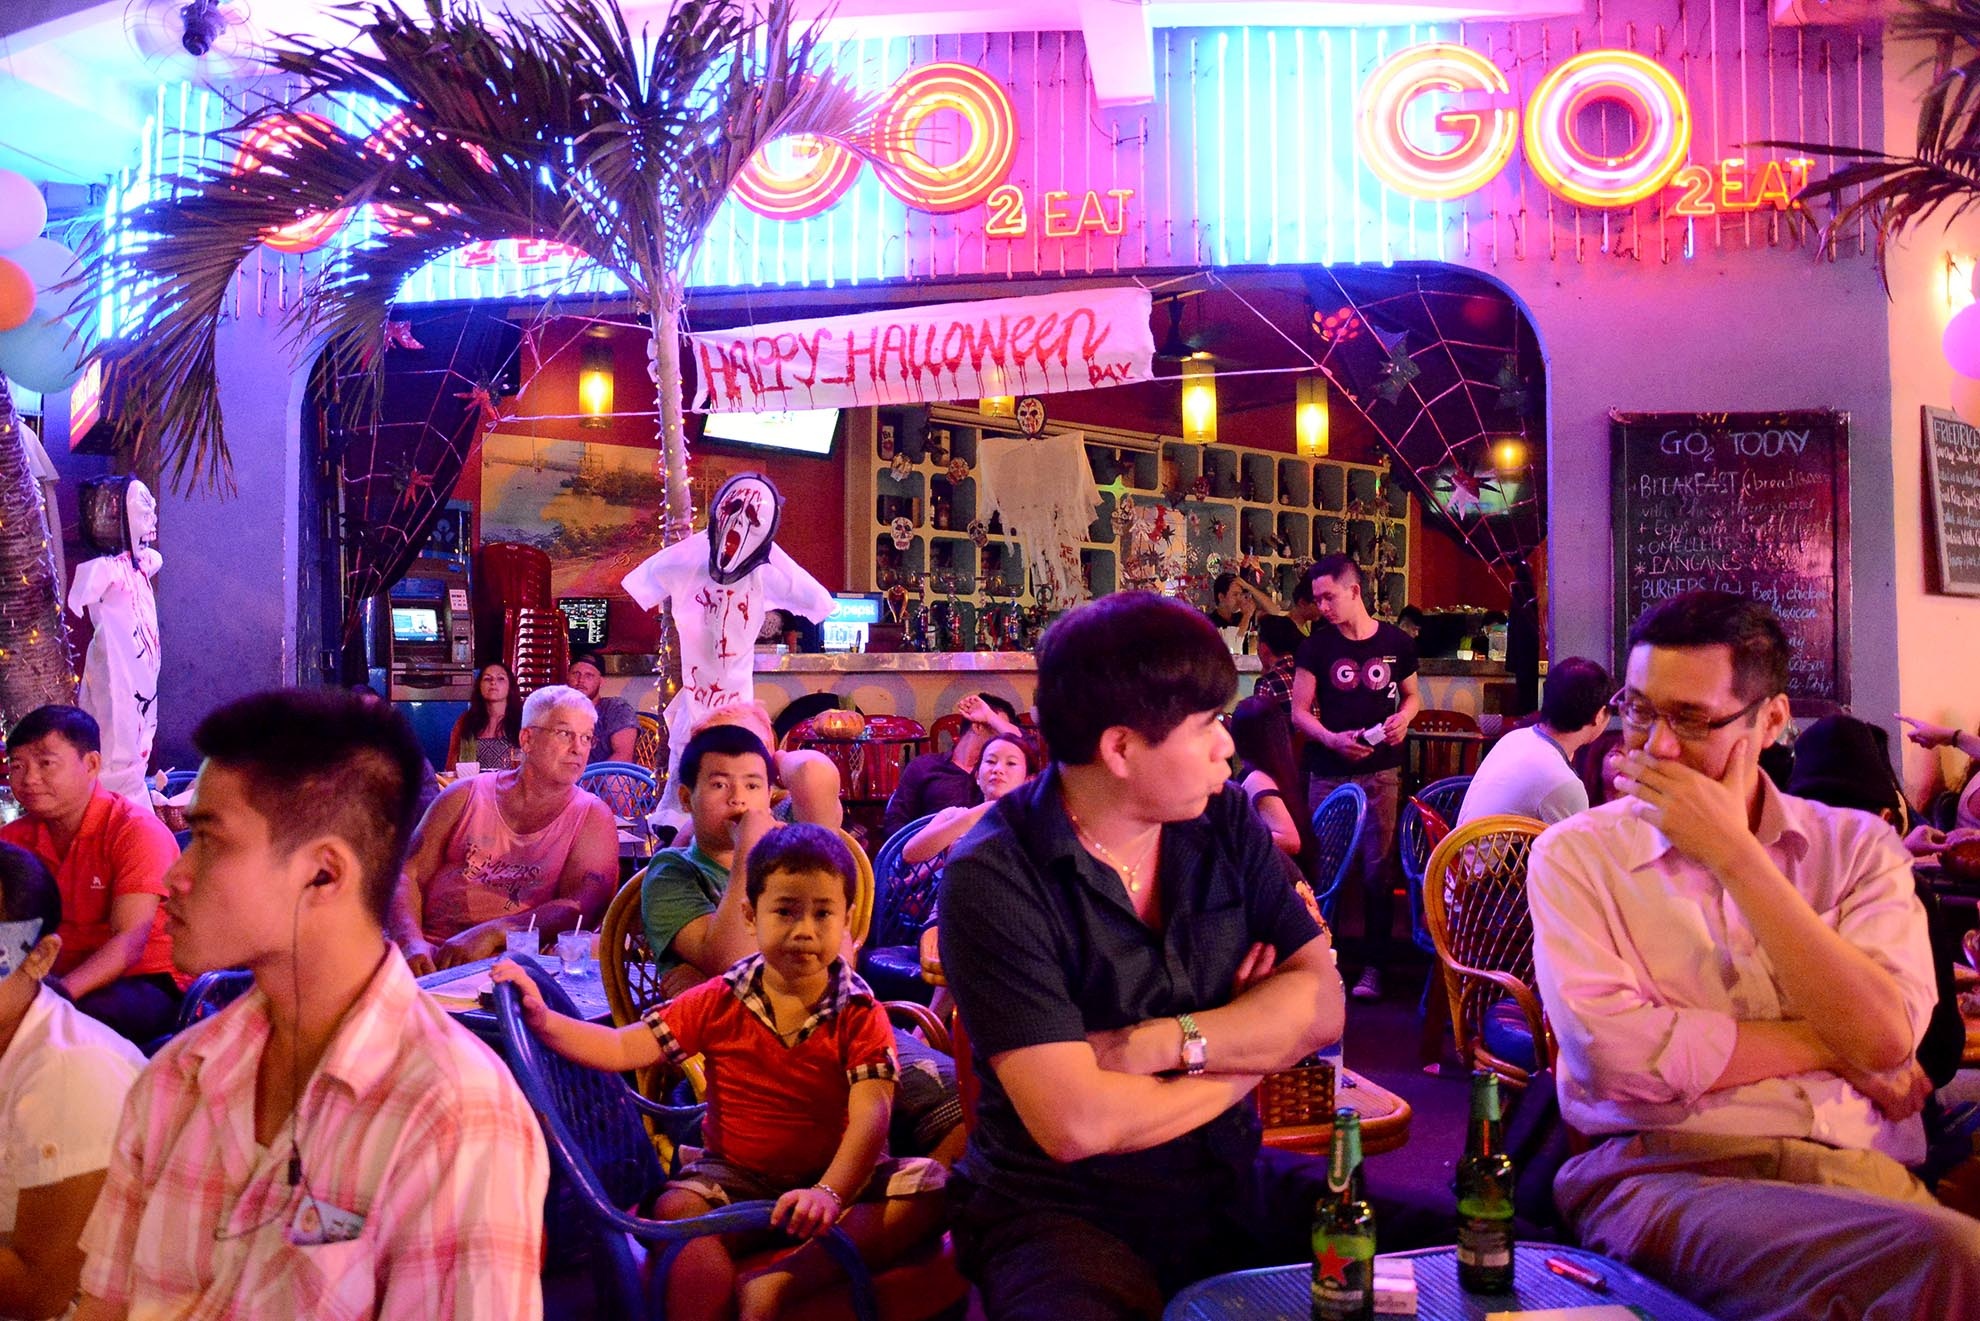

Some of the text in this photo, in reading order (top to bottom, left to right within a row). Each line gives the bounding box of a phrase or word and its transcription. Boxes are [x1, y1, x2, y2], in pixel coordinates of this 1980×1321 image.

[1357, 42, 1692, 208] GO
[699, 327, 833, 397] HAPPY
[1088, 360, 1136, 387] DAY
[1729, 429, 1811, 458] TODAY
